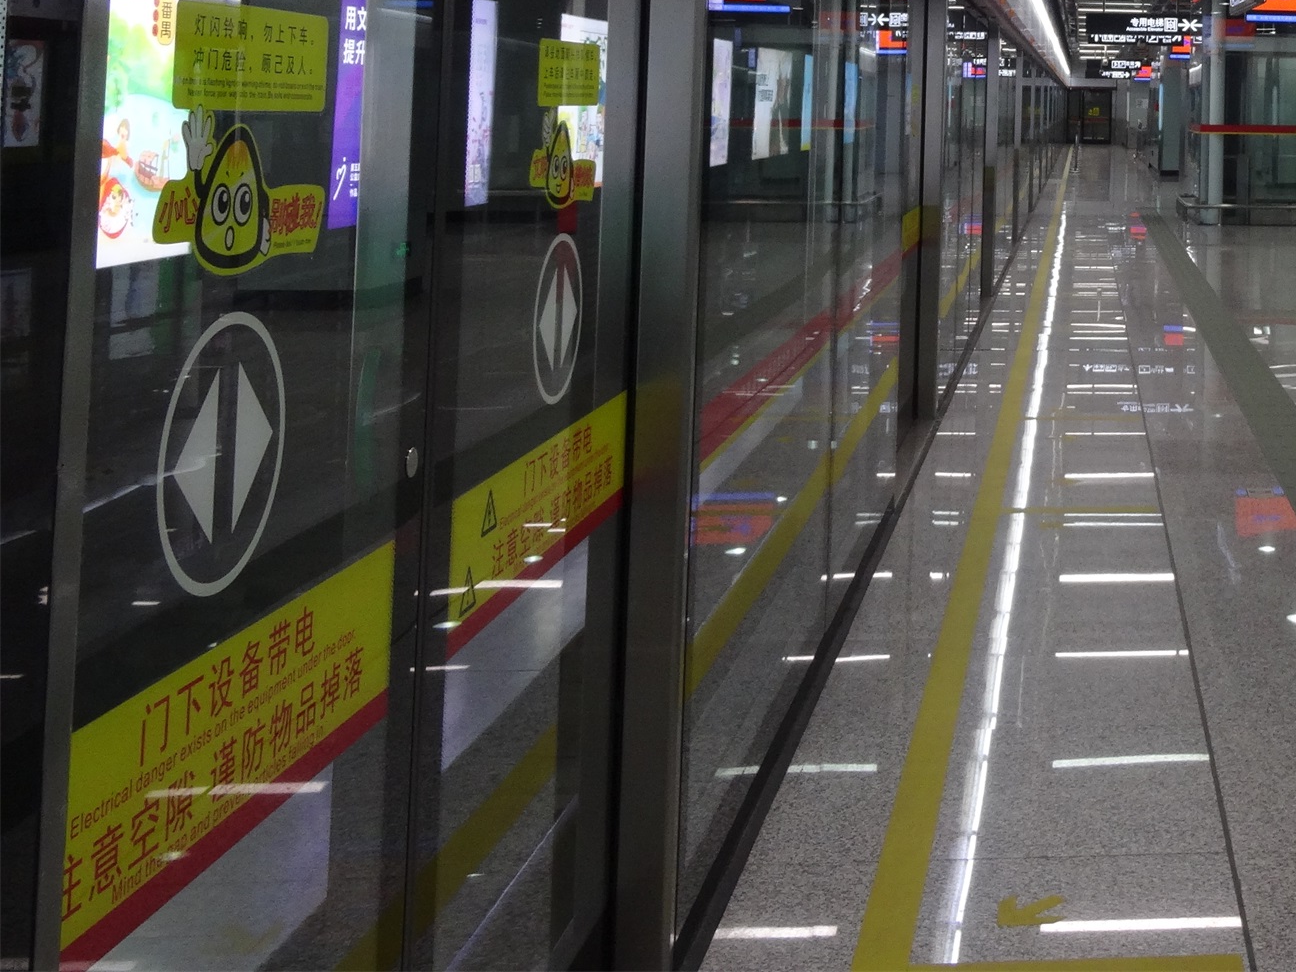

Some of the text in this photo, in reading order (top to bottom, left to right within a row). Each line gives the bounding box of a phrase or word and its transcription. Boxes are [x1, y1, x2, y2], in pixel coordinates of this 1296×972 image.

[1130, 17, 1164, 28] 专用电梯
[524, 422, 593, 498] 门下设备带电
[70, 779, 133, 840] Electrical
[135, 751, 178, 793] danger
[180, 729, 212, 762] exists
[214, 718, 228, 738] on
[230, 705, 246, 727] the
[247, 670, 296, 714] equipment
[297, 651, 322, 679] under
[140, 606, 315, 768] 门下设备带电
[210, 646, 364, 804] 谨防物品掉落
[112, 864, 142, 905] Mind
[190, 811, 211, 841] and
[213, 784, 255, 822] preve
